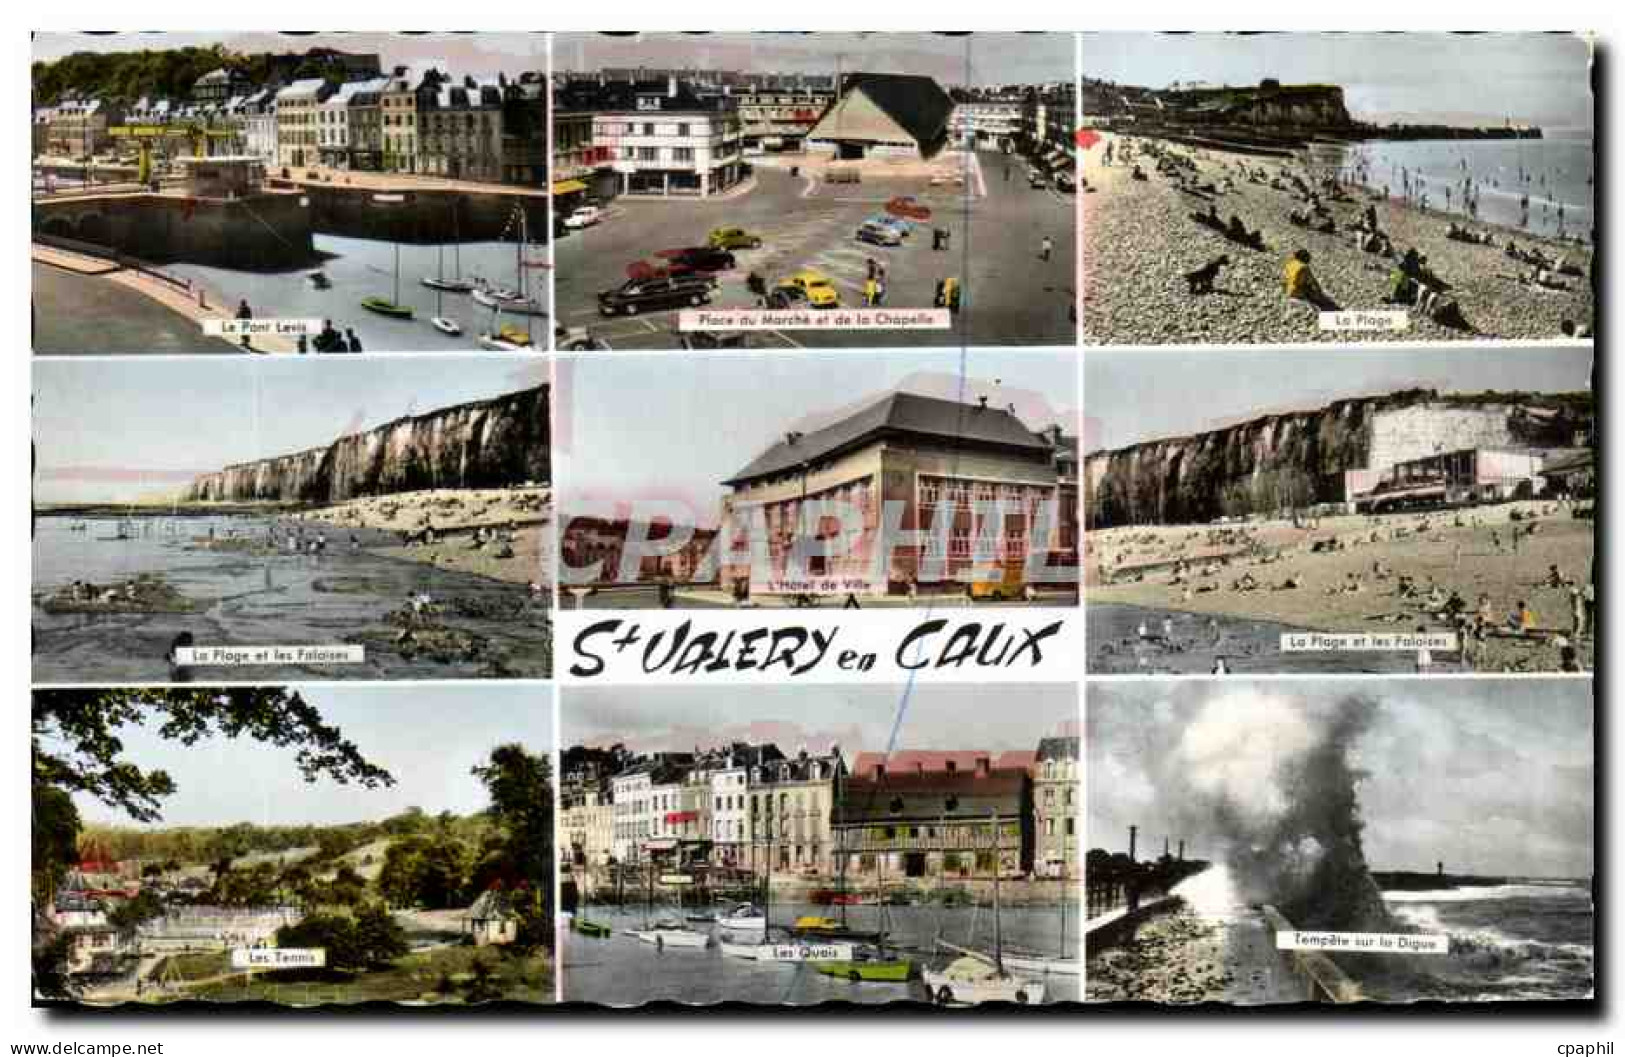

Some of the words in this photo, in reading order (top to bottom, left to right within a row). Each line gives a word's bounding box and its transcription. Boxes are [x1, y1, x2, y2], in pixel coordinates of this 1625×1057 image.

[221, 321, 236, 333] Le
[699, 313, 734, 326] Place
[739, 313, 756, 326] du
[761, 313, 811, 327] Marché
[815, 313, 831, 326] et
[835, 313, 853, 326] de
[856, 313, 870, 326] la
[874, 313, 935, 328] Chapelle
[1335, 314, 1351, 326] La
[1357, 314, 1393, 329] Plage
[820, 579, 838, 591] de
[842, 578, 872, 591] Ville
[837, 648, 877, 672] en
[896, 618, 1065, 672] CAUX
[1290, 635, 1306, 648] La
[1311, 635, 1347, 651] Plage
[1353, 635, 1367, 648] et
[1372, 635, 1391, 648] les
[194, 648, 209, 662] La
[213, 648, 250, 665] Plage
[256, 648, 269, 662] et
[274, 648, 293, 662] les
[297, 648, 350, 662] Falaises
[1354, 935, 1376, 947] sur
[1379, 935, 1394, 948] la
[1397, 937, 1438, 951] Digue
[249, 951, 269, 964] Les
[275, 951, 316, 964] Tennis
[773, 946, 795, 959] Les
[798, 945, 838, 960] Quais
